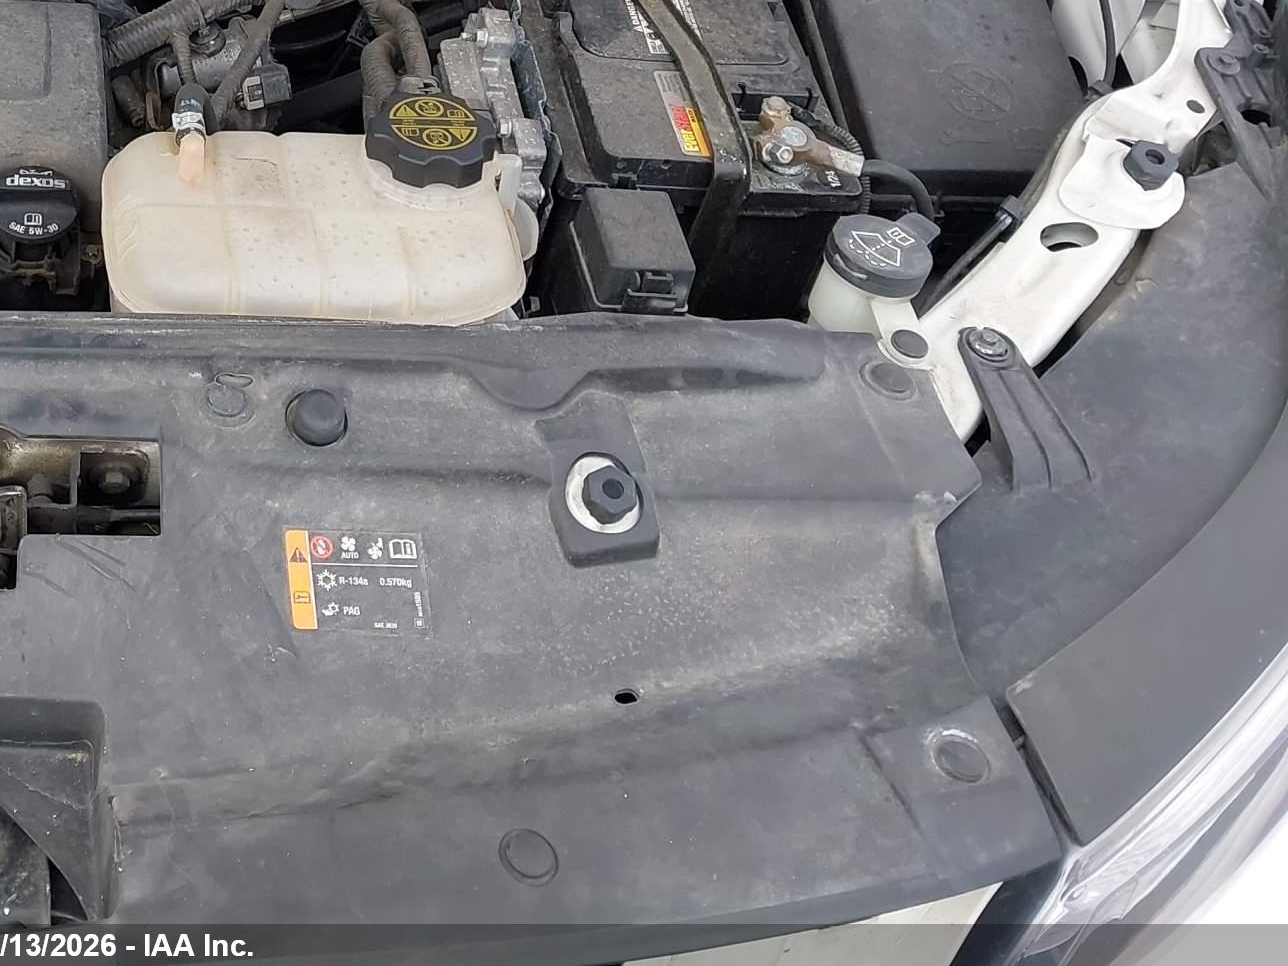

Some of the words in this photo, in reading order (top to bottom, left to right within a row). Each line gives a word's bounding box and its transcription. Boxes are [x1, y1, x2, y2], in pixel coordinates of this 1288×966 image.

[9, 221, 26, 234] SAE
[28, 223, 59, 235] 5W-30
[338, 577, 369, 586] R-134a
[379, 577, 413, 588] 0.570kg
[343, 606, 361, 616] PAG
